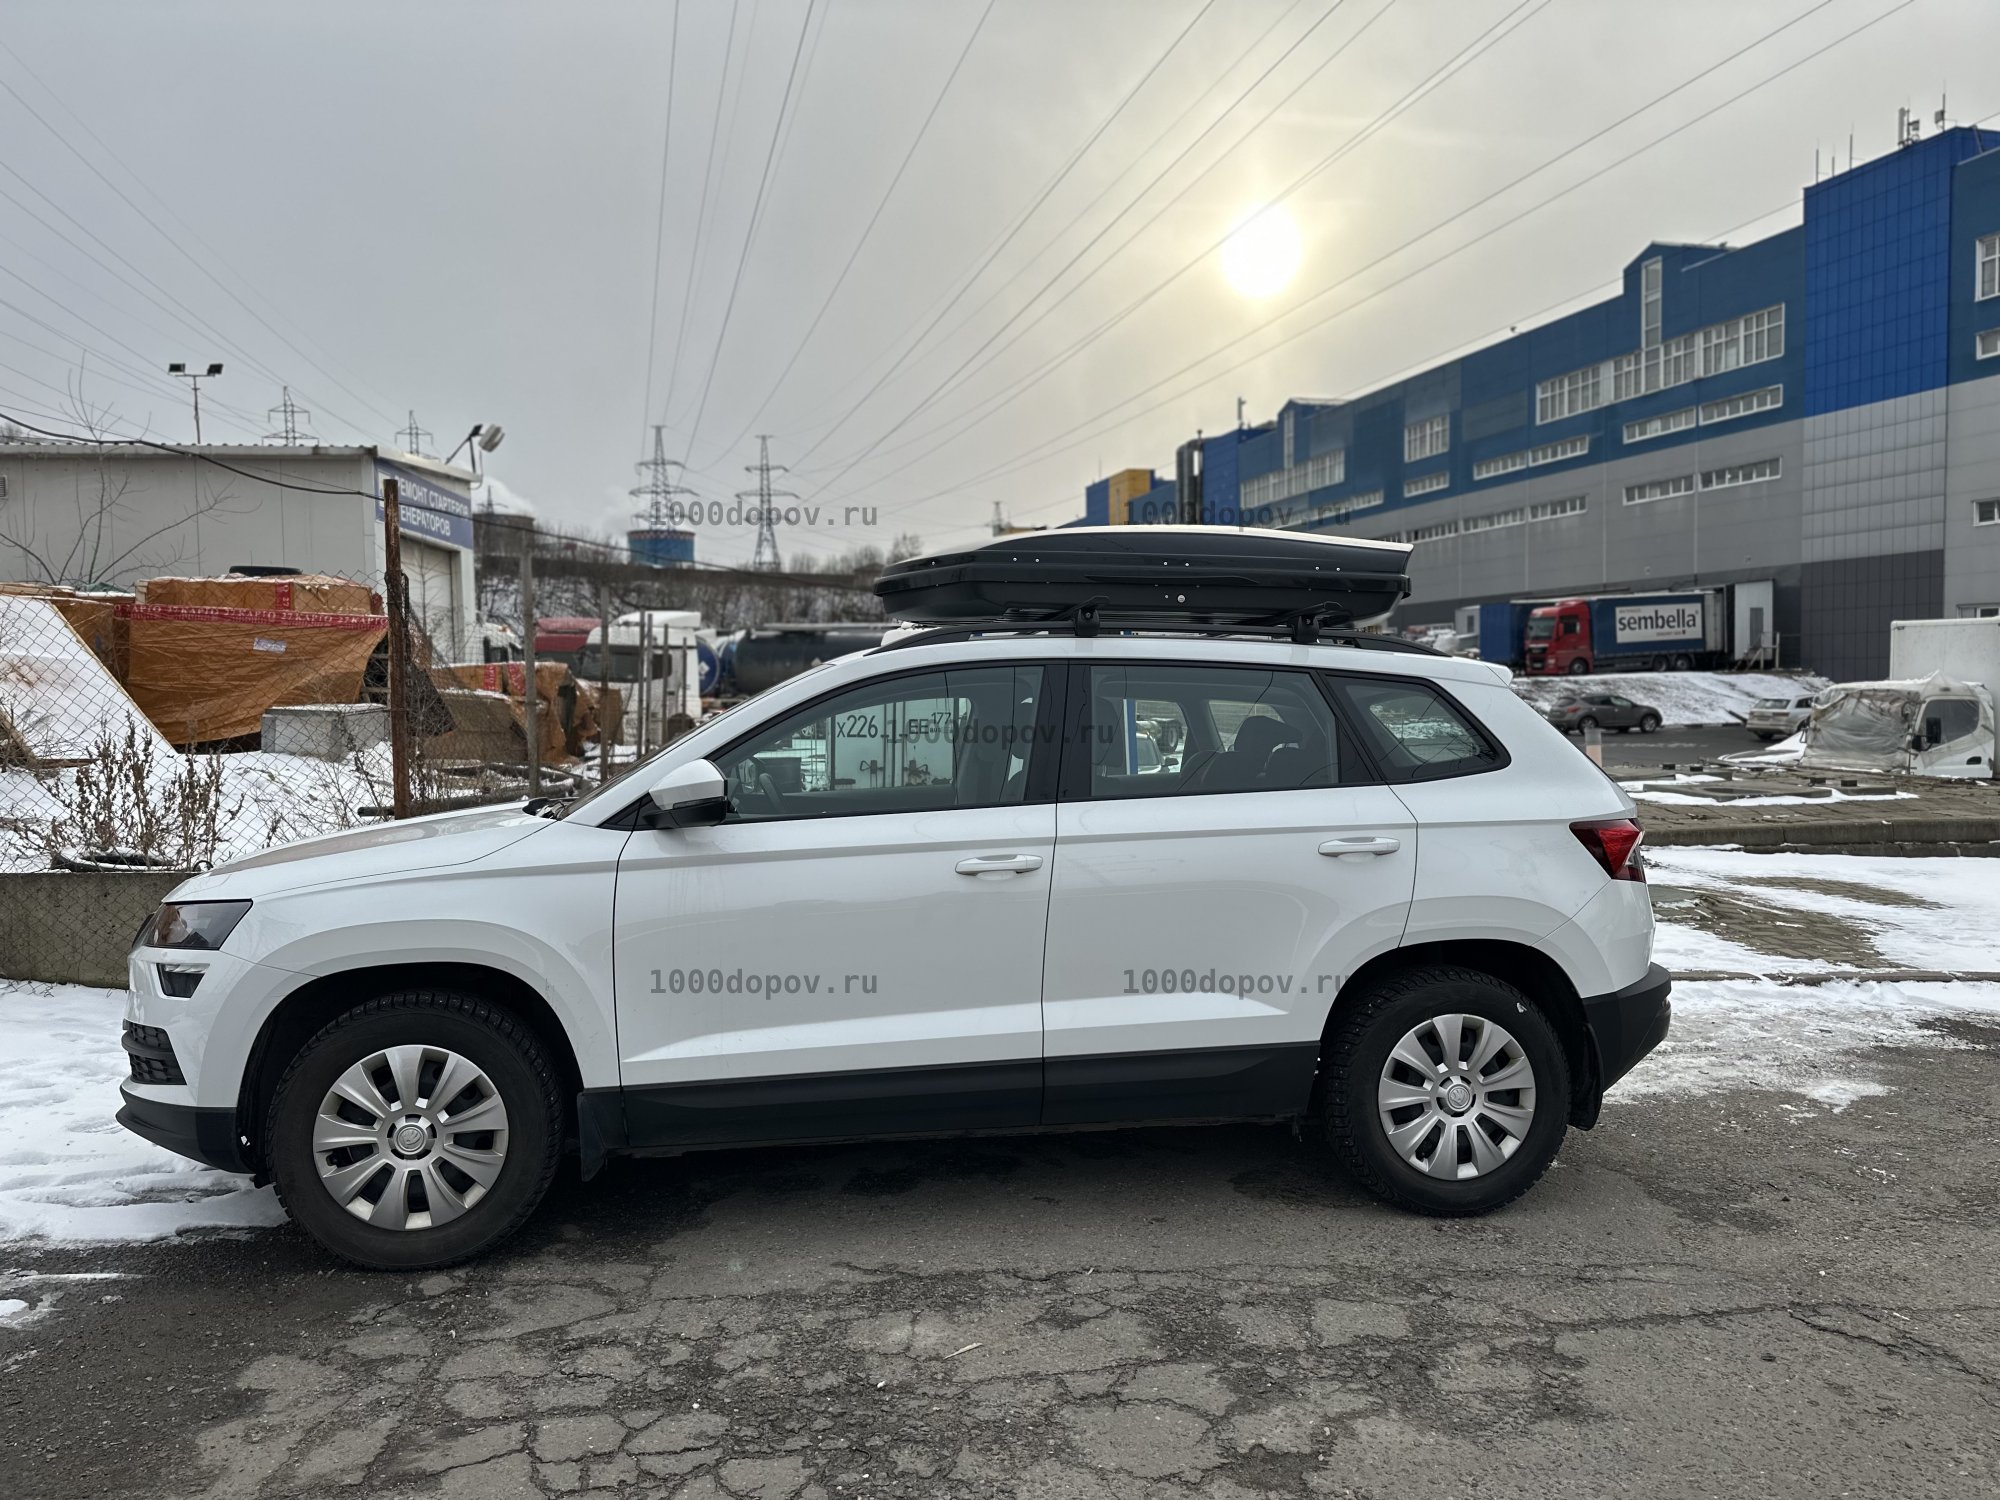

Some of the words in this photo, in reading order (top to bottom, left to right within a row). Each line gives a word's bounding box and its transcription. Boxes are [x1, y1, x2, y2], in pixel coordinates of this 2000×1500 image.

[399, 505, 451, 537] ЕНЕРАТОРОВ
[1618, 609, 1696, 631] sembella
[931, 712, 951, 725] 177
